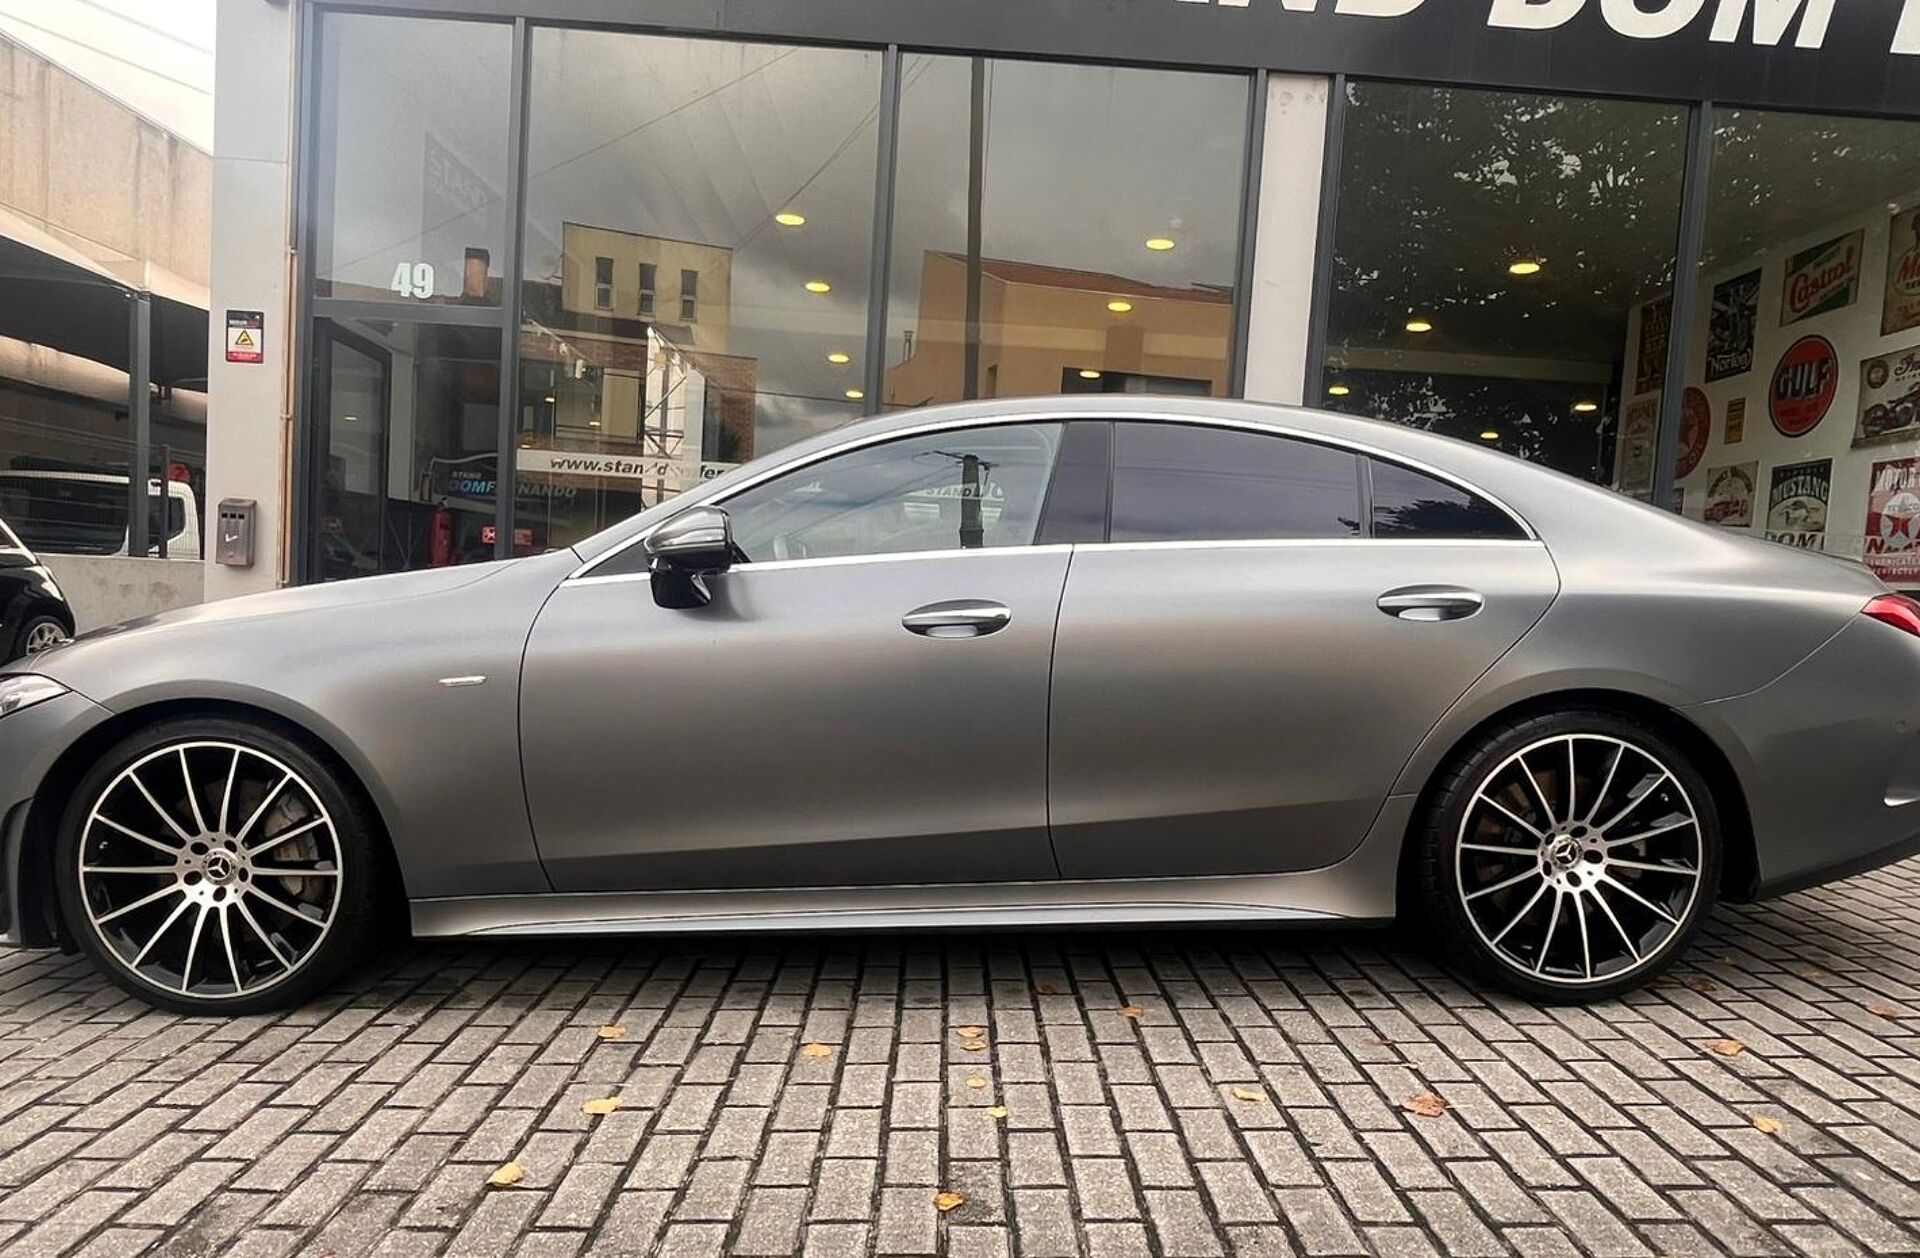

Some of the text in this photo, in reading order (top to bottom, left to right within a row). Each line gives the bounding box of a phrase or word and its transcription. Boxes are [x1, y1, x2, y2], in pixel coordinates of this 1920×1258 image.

[390, 262, 435, 300] 49
[1708, 349, 1752, 377] Norton
[1776, 356, 1832, 401] GULF
[1771, 475, 1829, 505] MUSTANG
